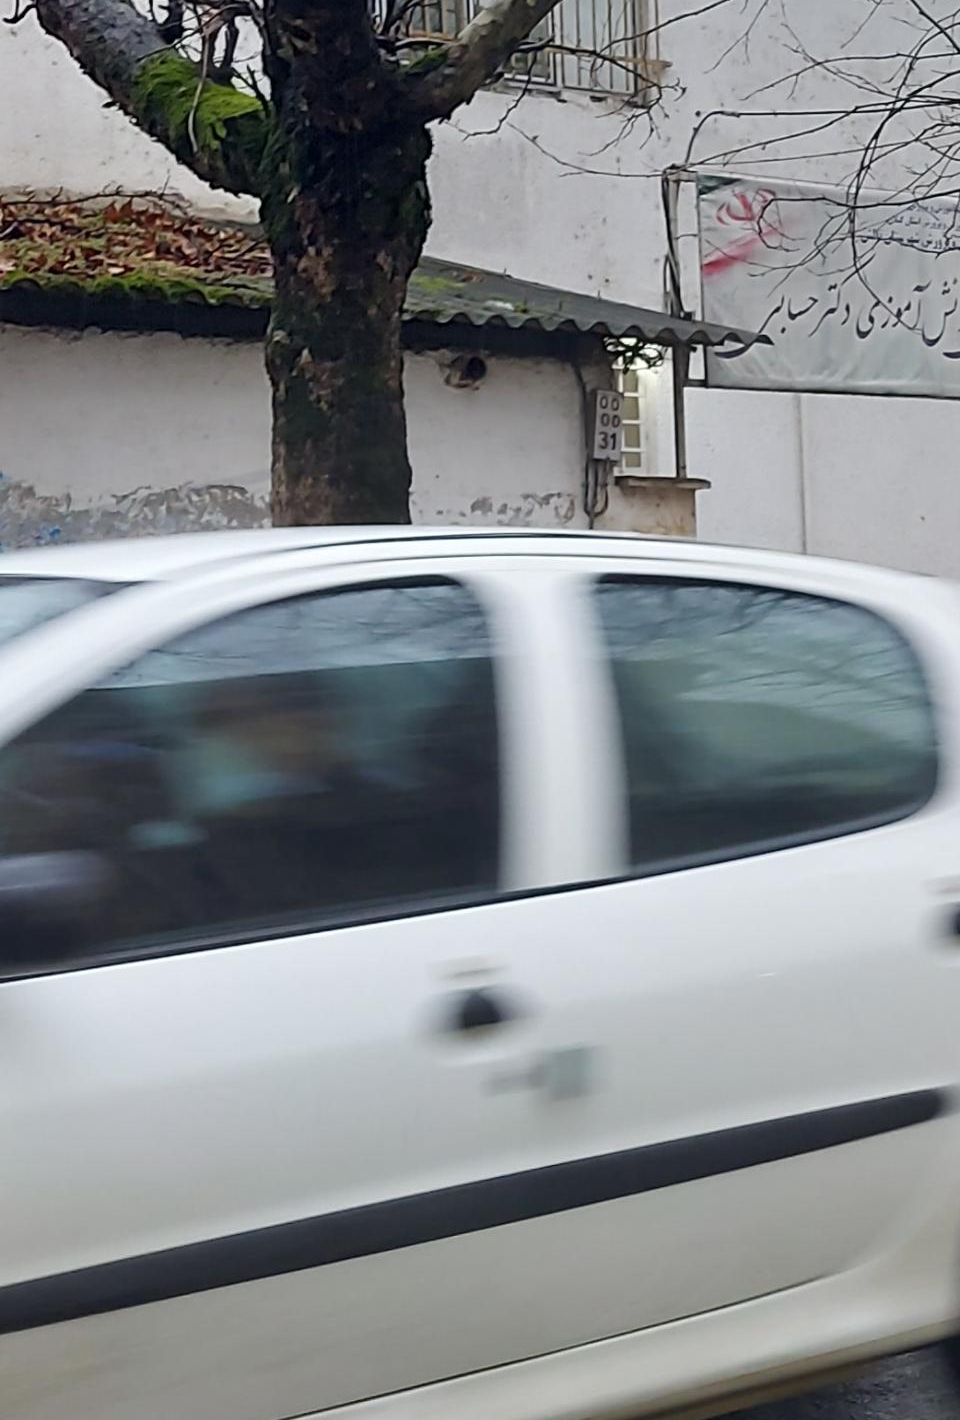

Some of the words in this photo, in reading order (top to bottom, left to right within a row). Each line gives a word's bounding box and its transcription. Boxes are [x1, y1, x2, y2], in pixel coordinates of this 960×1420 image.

[809, 283, 850, 337] دکتر
[600, 395, 620, 411] 00
[601, 413, 621, 428] 00
[598, 431, 617, 450] 31
